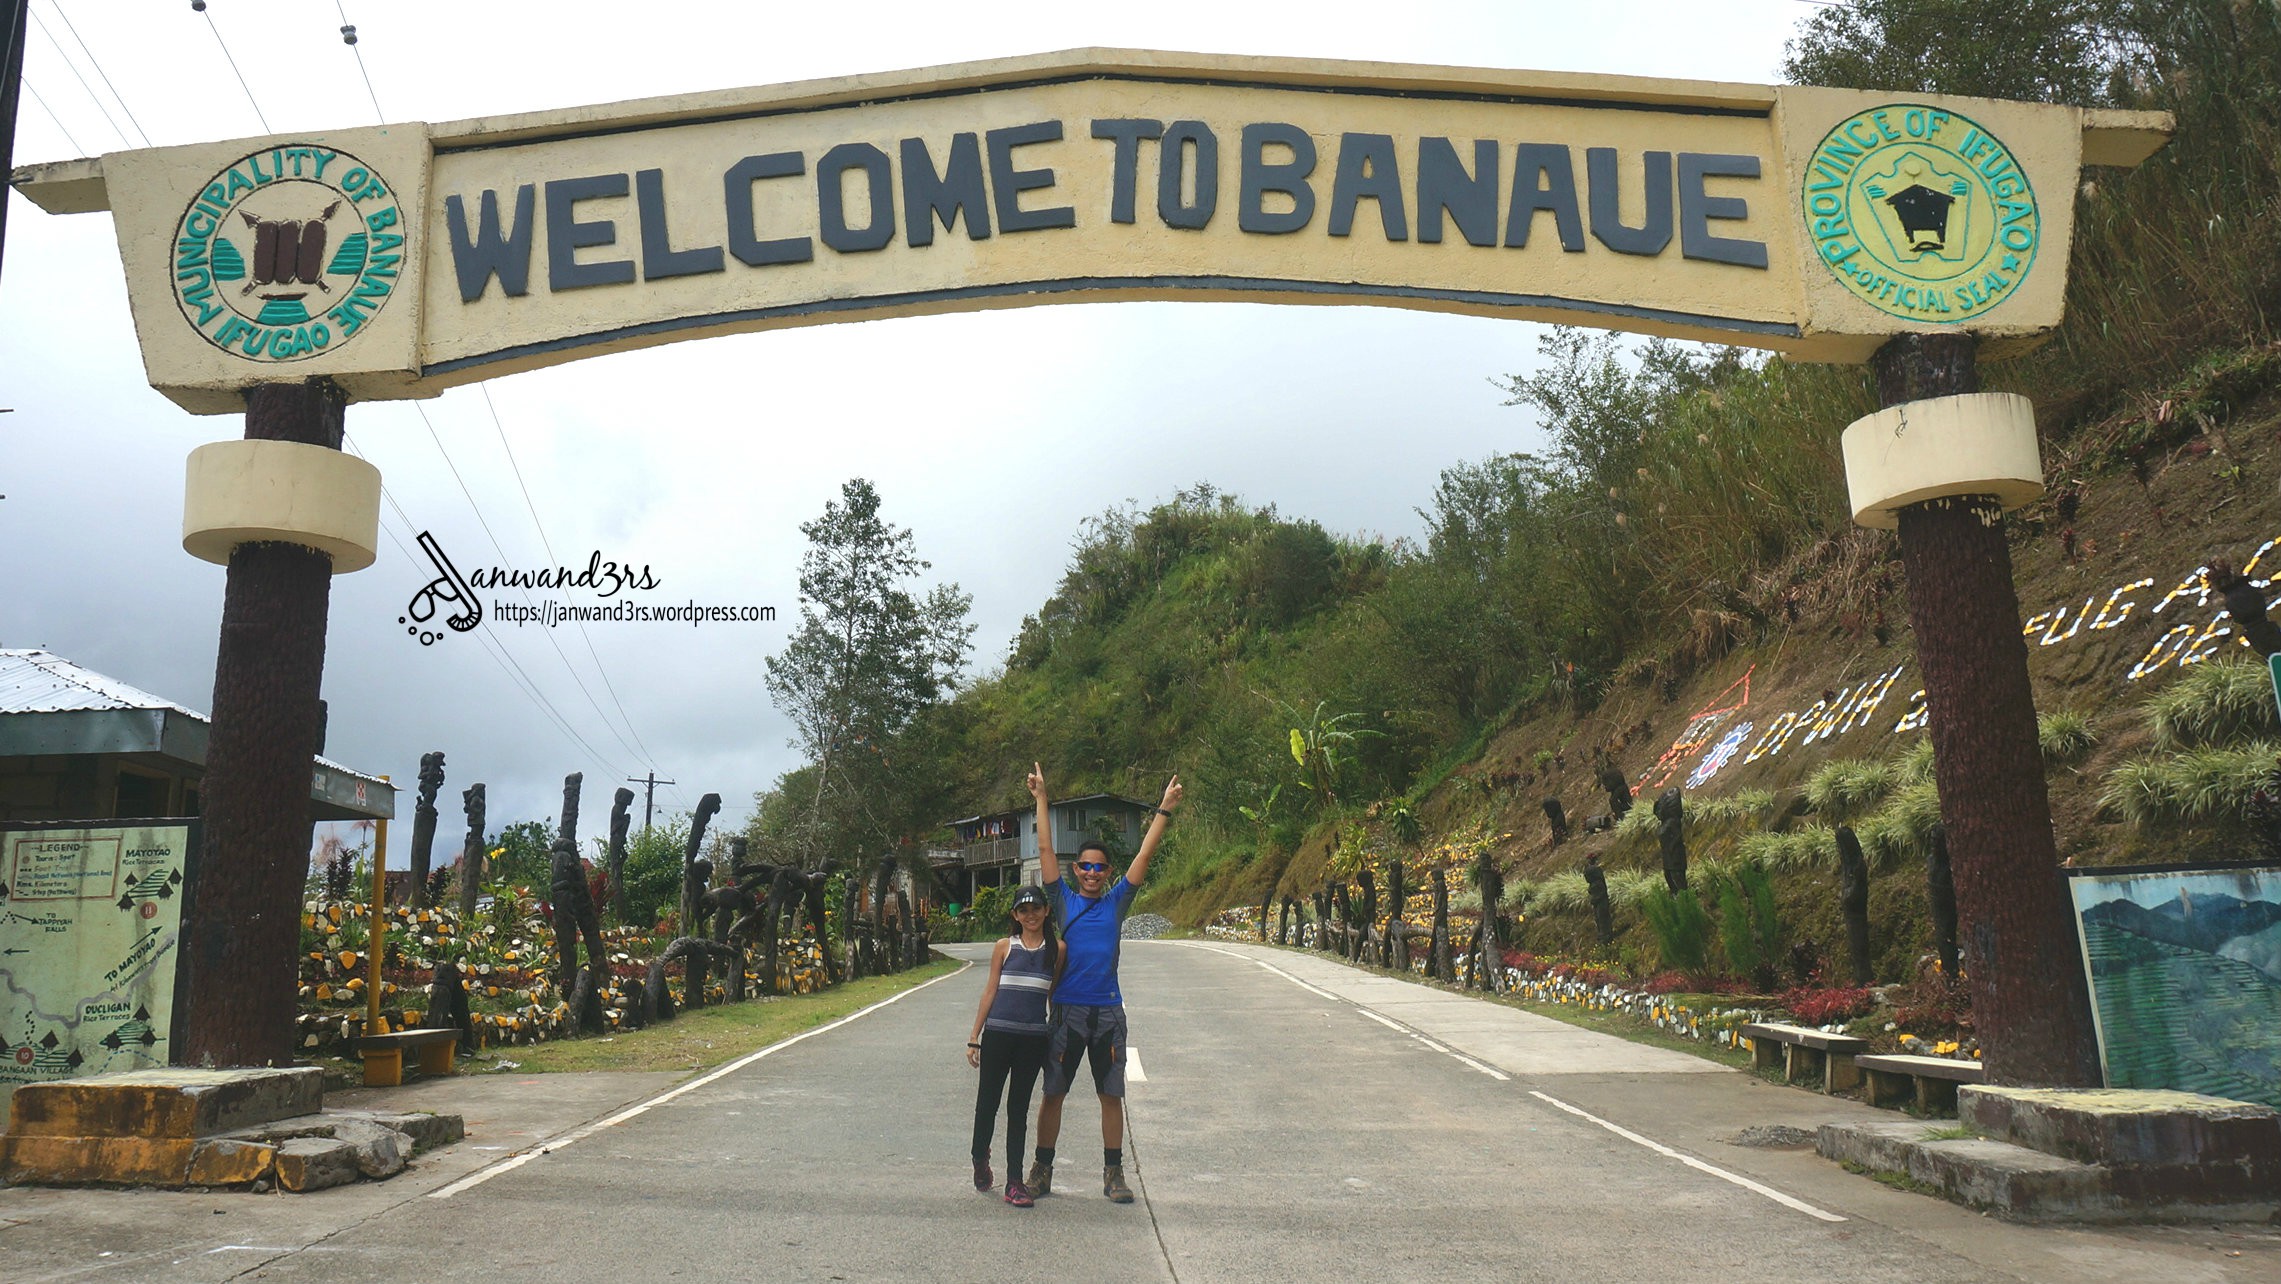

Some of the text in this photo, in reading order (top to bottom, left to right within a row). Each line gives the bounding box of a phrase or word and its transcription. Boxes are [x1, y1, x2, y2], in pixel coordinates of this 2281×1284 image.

[1808, 109, 2034, 264] PROVINCE OF IFUGAO
[447, 119, 1769, 304] WELCOME TO BANAUE
[177, 149, 404, 337] MUNICIPALITY OF BANAUE
[1856, 270, 2010, 313] OFFICIAL SEAL
[213, 315, 330, 359] IFUGAO
[125, 849, 171, 858] MAYOYAO
[104, 938, 156, 982] TO MAYOYAO
[83, 1014, 98, 1022] Rice
[85, 1002, 131, 1014] DUCLIGAN
